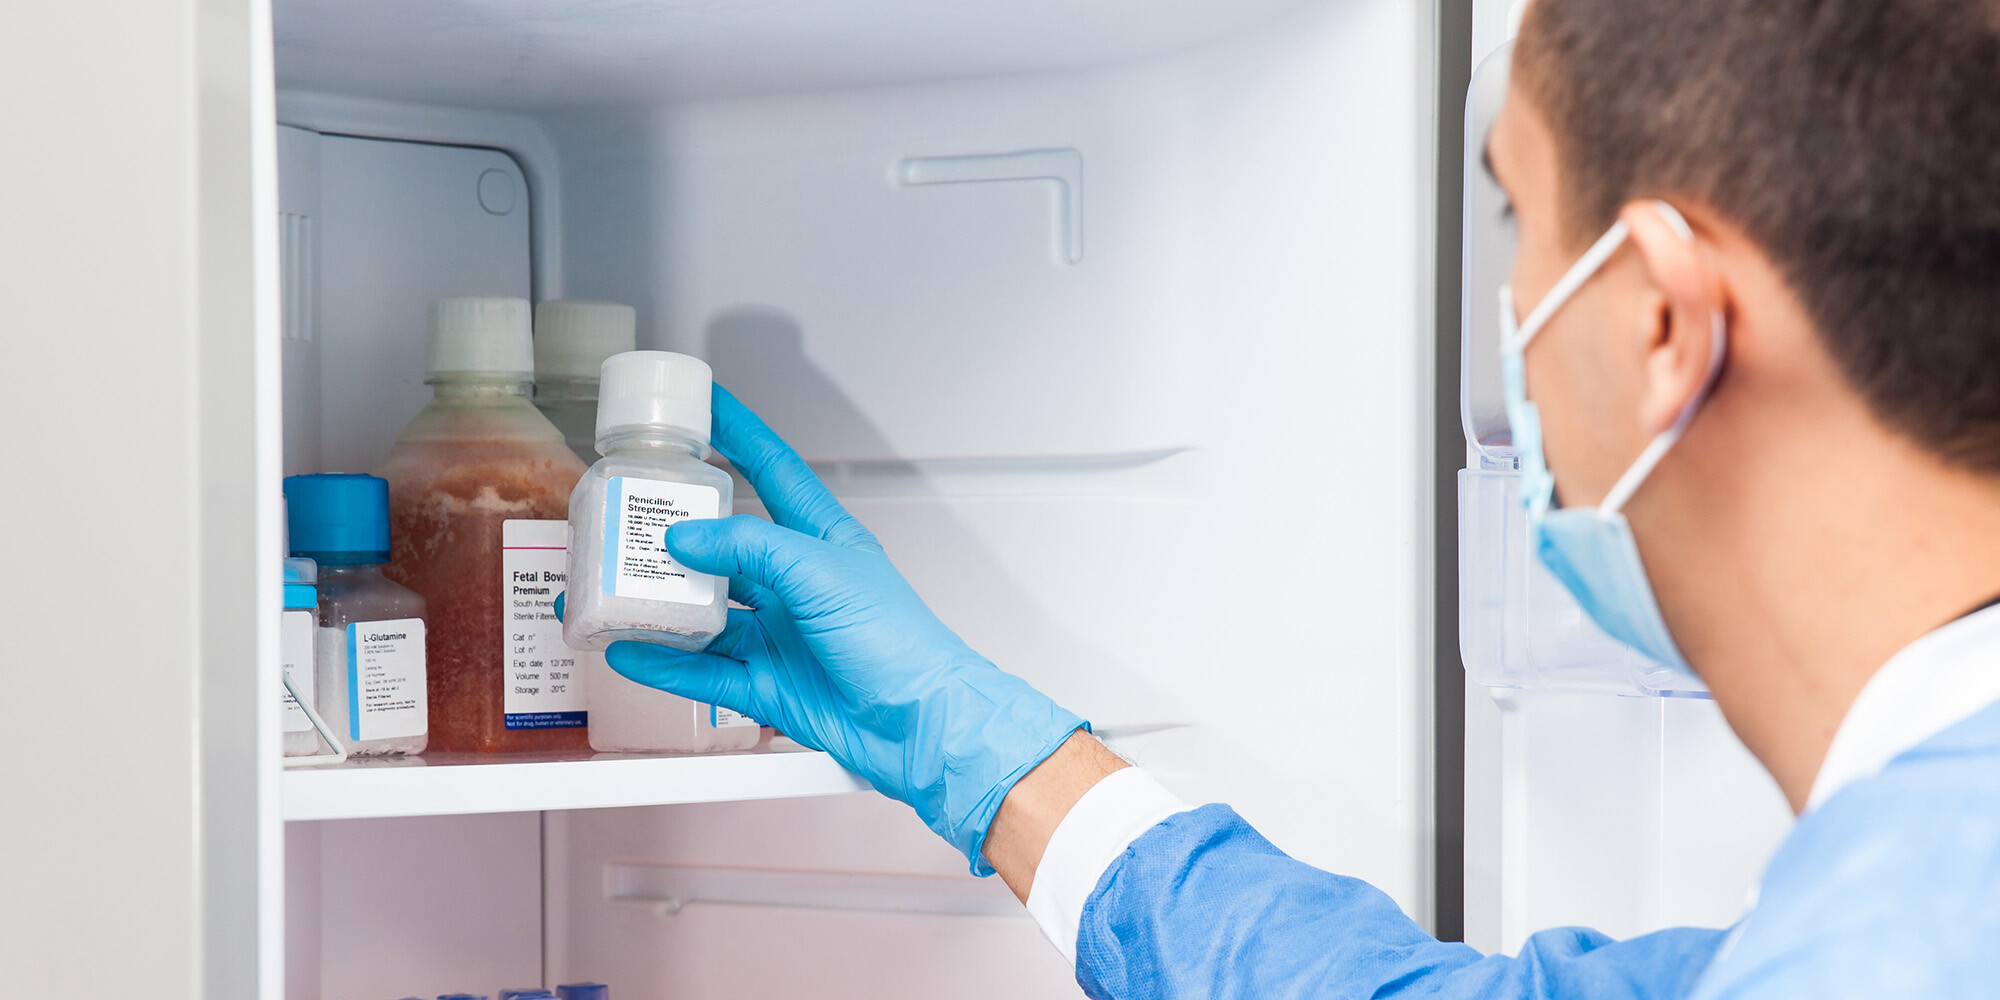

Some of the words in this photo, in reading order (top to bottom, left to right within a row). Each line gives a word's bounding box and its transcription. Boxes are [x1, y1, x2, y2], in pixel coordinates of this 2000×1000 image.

[628, 495, 674, 506] Penicillin/
[628, 504, 689, 517] Streptomycin
[513, 571, 538, 582] Fetal
[651, 570, 685, 578] Manufacturing
[513, 586, 550, 595] Premium
[364, 632, 406, 642] L-Glutamine
[514, 646, 525, 654] Lot
[550, 672, 561, 680] 500
[514, 686, 539, 695] Storage
